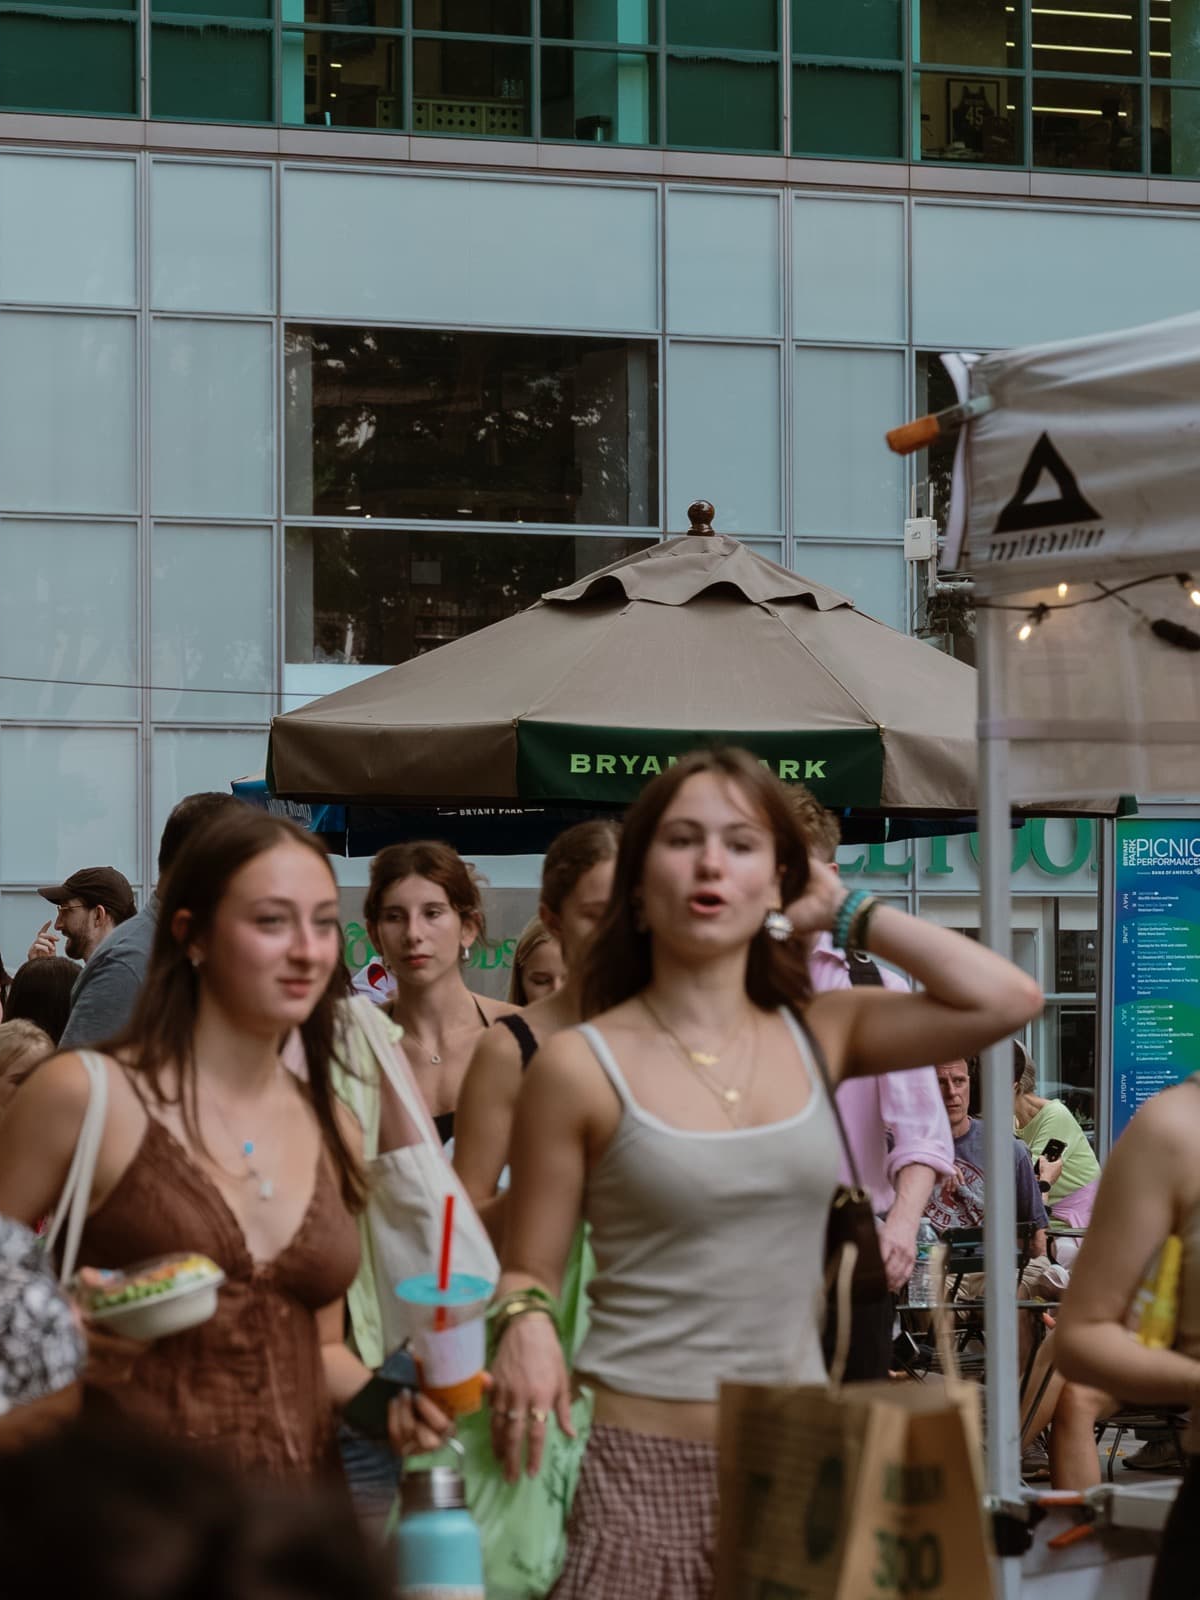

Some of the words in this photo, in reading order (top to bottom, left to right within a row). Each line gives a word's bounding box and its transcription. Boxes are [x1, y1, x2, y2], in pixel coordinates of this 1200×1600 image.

[570, 753, 680, 776] BRYA
[758, 759, 827, 779] RK
[1136, 857, 1200, 866] PERFORMANCE
